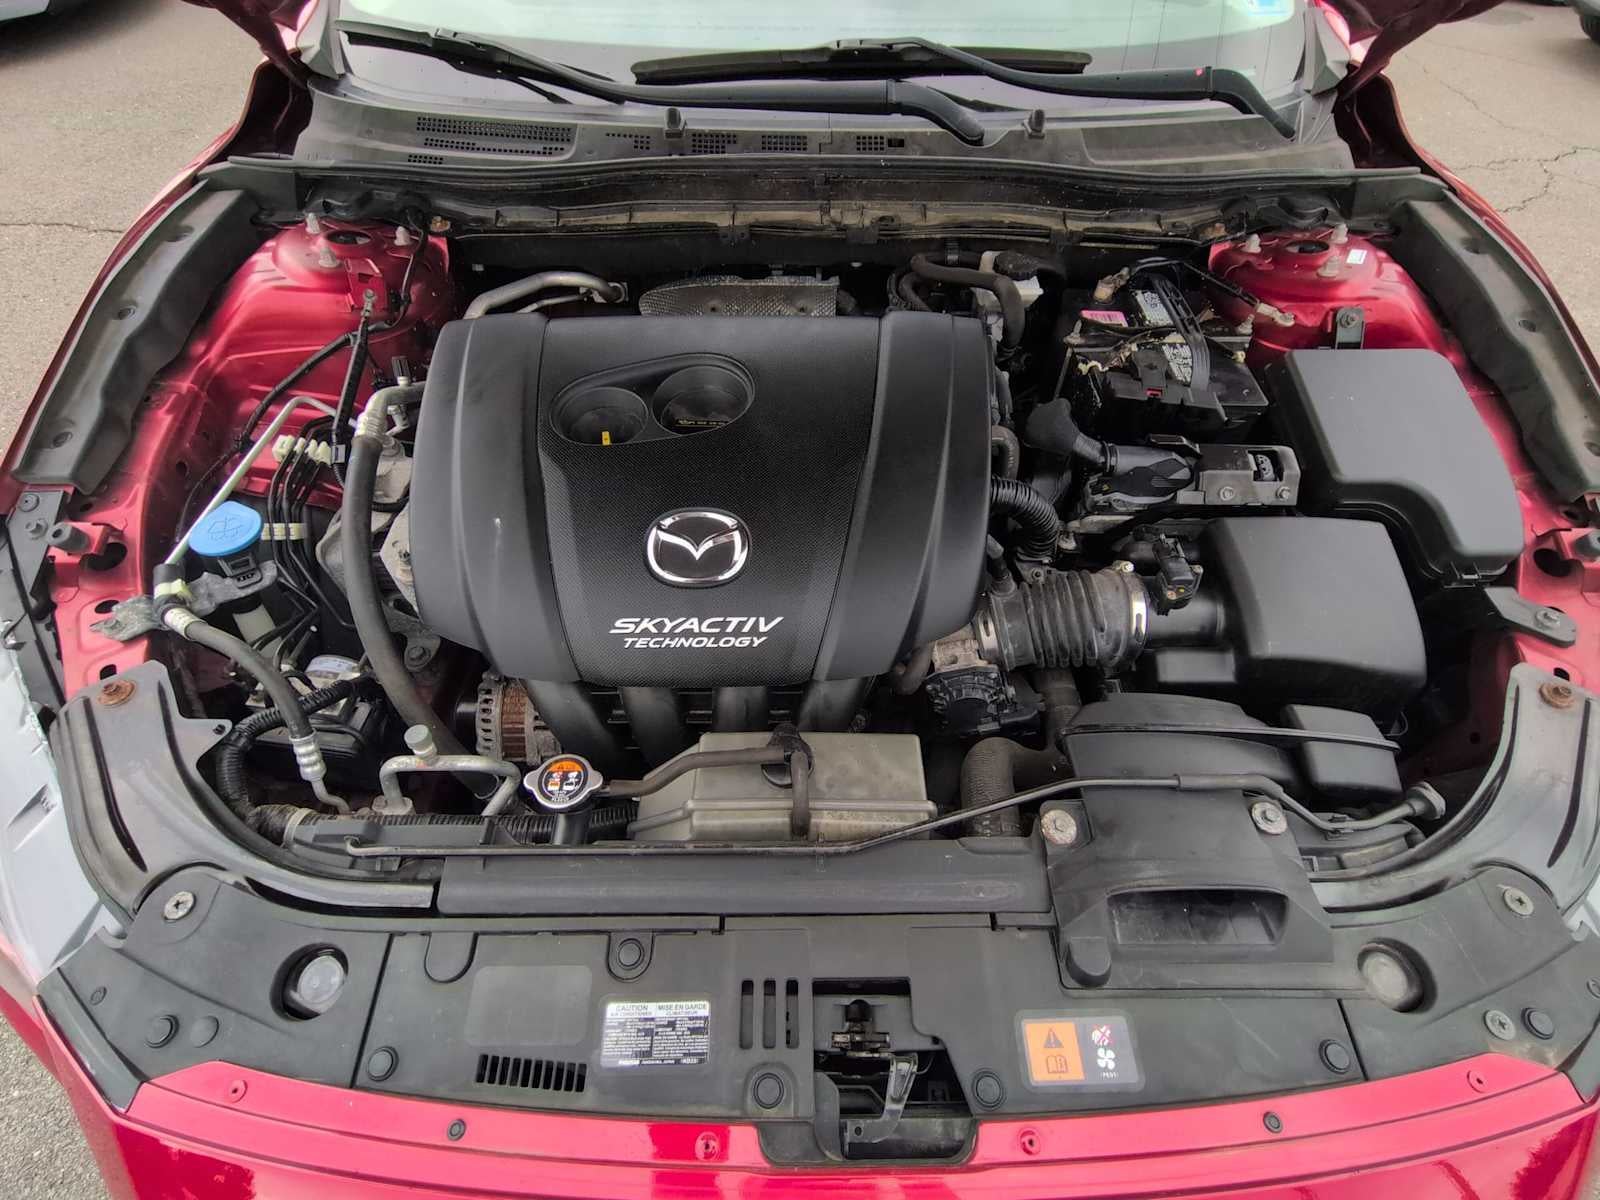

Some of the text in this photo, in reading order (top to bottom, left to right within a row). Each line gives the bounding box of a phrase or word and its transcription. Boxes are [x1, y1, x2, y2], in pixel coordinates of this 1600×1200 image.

[608, 616, 784, 634] SKYACTIV
[624, 636, 768, 649] TECHNOLOGY
[615, 1004, 649, 1012] CAUTION
[658, 1003, 674, 1011] MISE
[684, 1002, 706, 1010] GARDE
